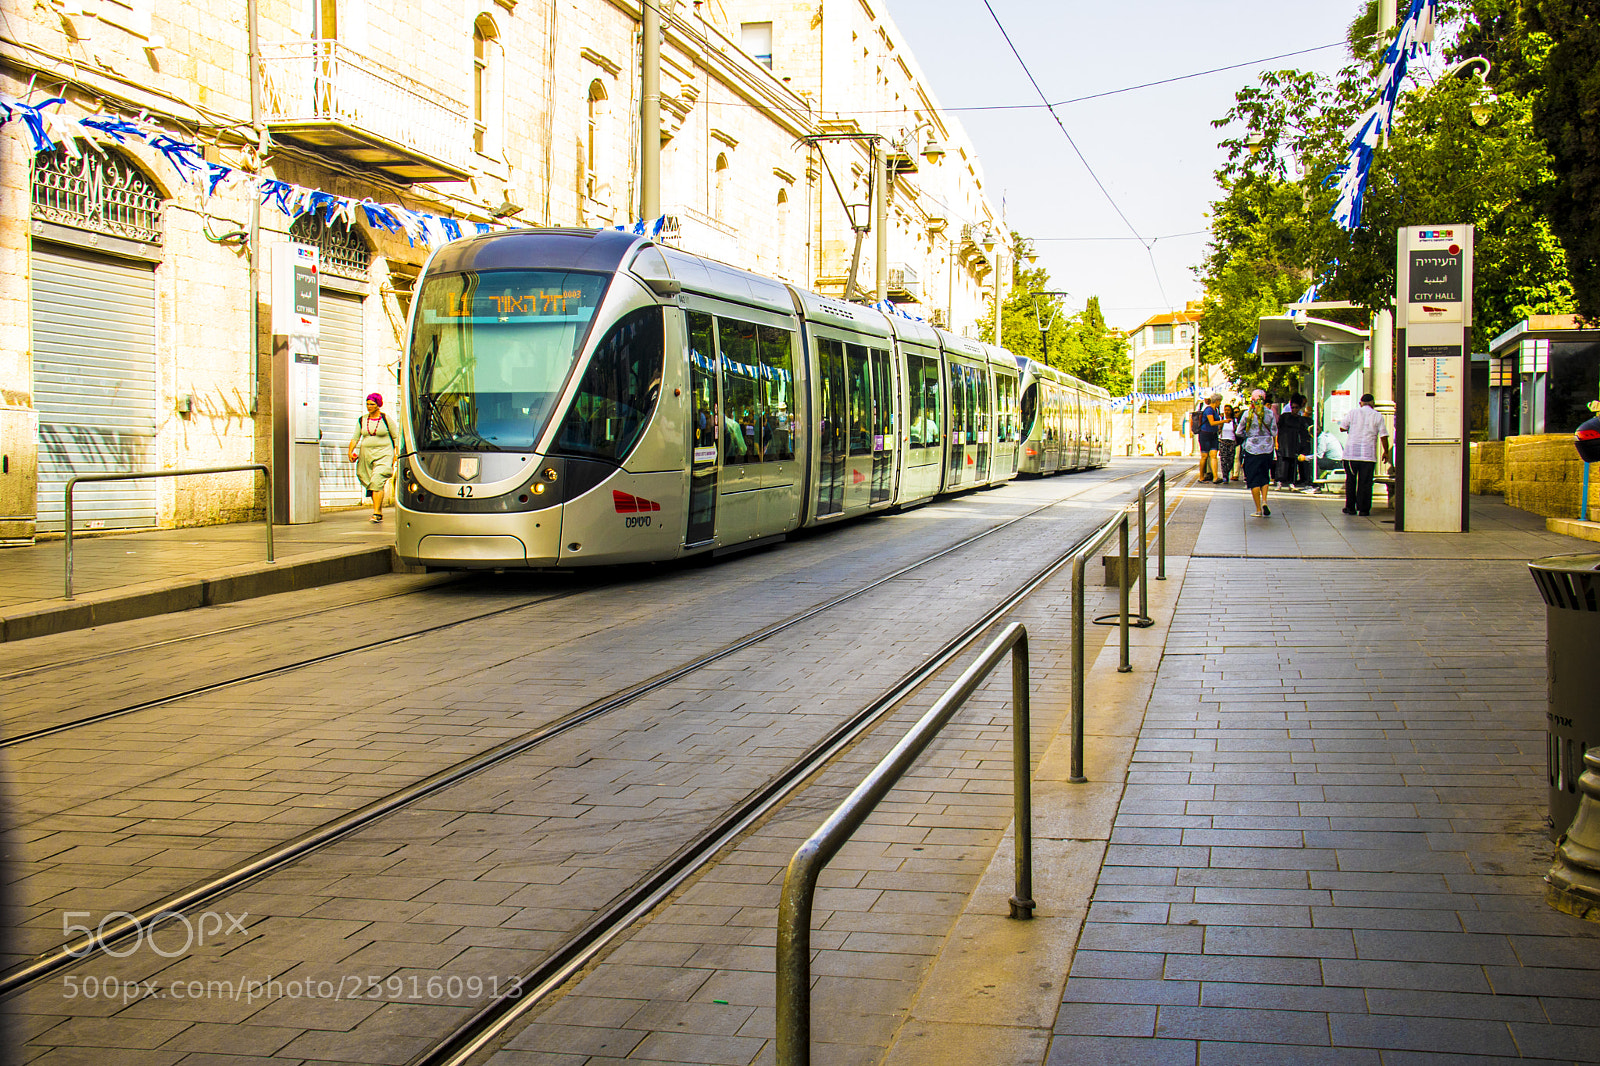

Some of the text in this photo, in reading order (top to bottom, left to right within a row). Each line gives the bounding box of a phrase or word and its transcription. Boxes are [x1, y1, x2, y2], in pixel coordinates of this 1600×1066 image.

[1416, 258, 1457, 266] העירייה
[448, 292, 470, 317] L1
[488, 291, 566, 313] חיל האוויר
[457, 485, 473, 498] 42
[625, 515, 652, 529] סיטיפס
